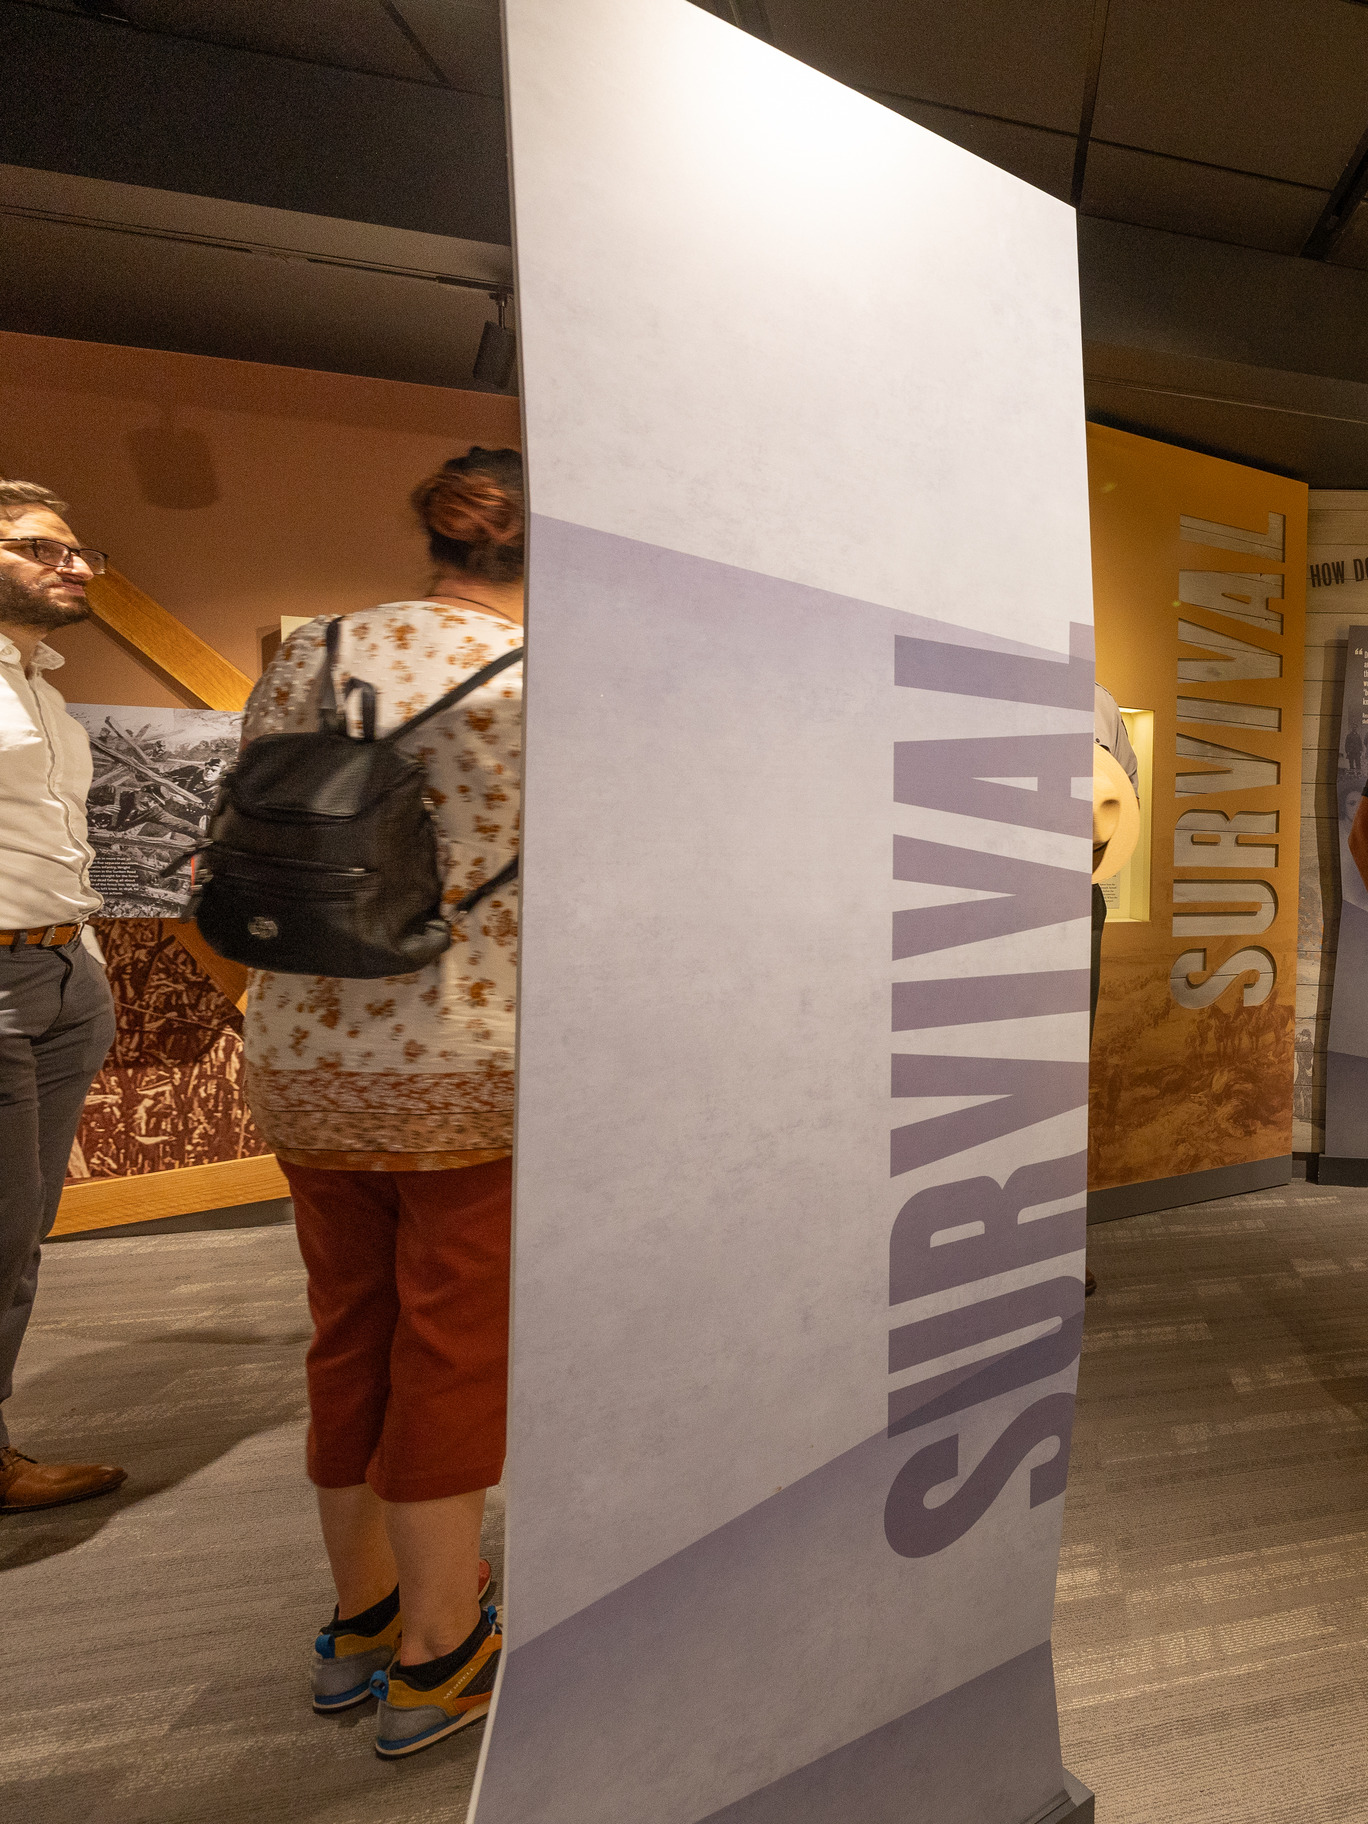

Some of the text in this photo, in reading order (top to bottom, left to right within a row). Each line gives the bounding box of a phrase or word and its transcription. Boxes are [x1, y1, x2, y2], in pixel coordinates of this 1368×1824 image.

[1169, 511, 1287, 1009] SURVIVAL
[1310, 561, 1345, 588] HOW
[883, 622, 1096, 1559] SURVIVAL
